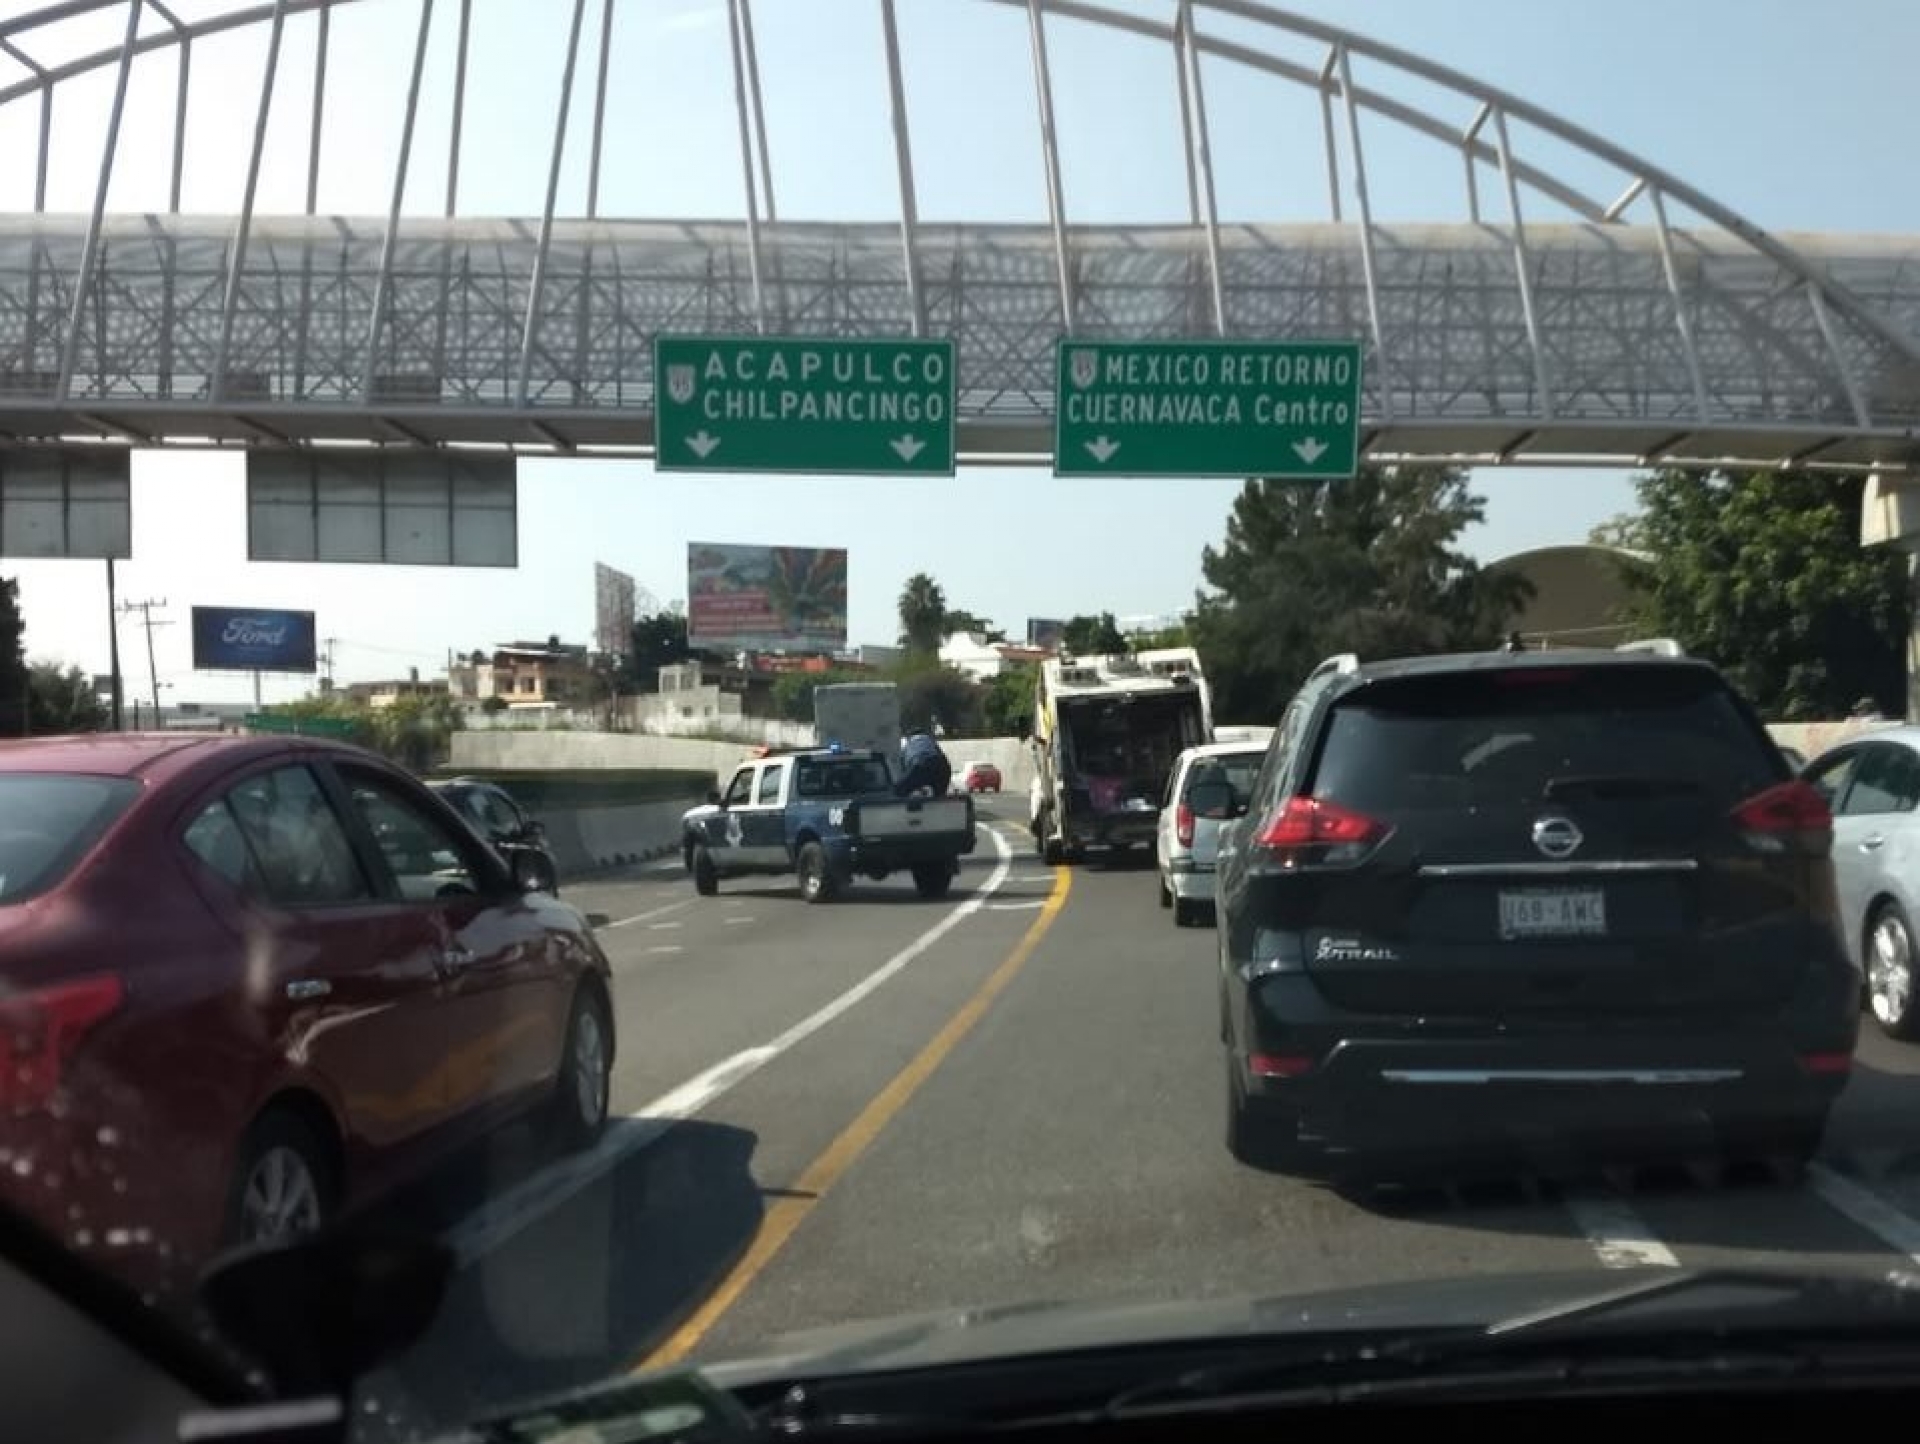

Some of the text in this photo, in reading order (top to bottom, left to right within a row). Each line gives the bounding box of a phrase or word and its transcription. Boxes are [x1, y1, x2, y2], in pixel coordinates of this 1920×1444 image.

[703, 351, 944, 383] ACAPULCO
[1104, 353, 1211, 385] MEXICO
[1220, 355, 1351, 386] RETORNO
[703, 389, 944, 422] CHILPANCINGO
[1066, 393, 1349, 425] CUERNAVACA Centro
[221, 618, 287, 645] Ford
